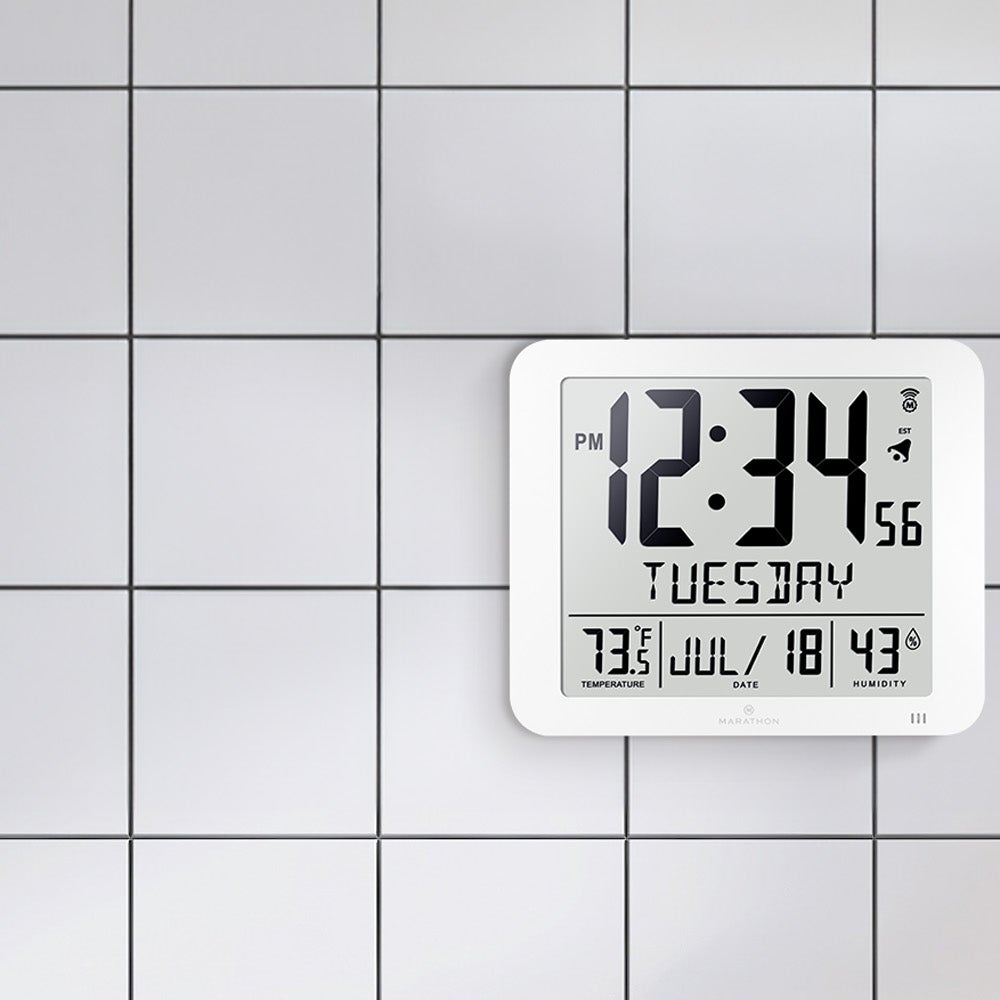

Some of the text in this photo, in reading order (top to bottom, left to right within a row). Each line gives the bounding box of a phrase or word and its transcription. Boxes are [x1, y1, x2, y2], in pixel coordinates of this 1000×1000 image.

[898, 427, 912, 435] EST
[574, 432, 604, 451] PM
[608, 388, 868, 547] 12:34
[875, 501, 923, 547] 56
[642, 561, 854, 605] TUESDAY
[787, 628, 824, 675] 18
[850, 627, 900, 675] 43
[581, 680, 645, 688] TEMPERATURE
[733, 681, 759, 689] DATE
[853, 680, 907, 688] HUMIDITY
[718, 717, 780, 725] MARATHON
